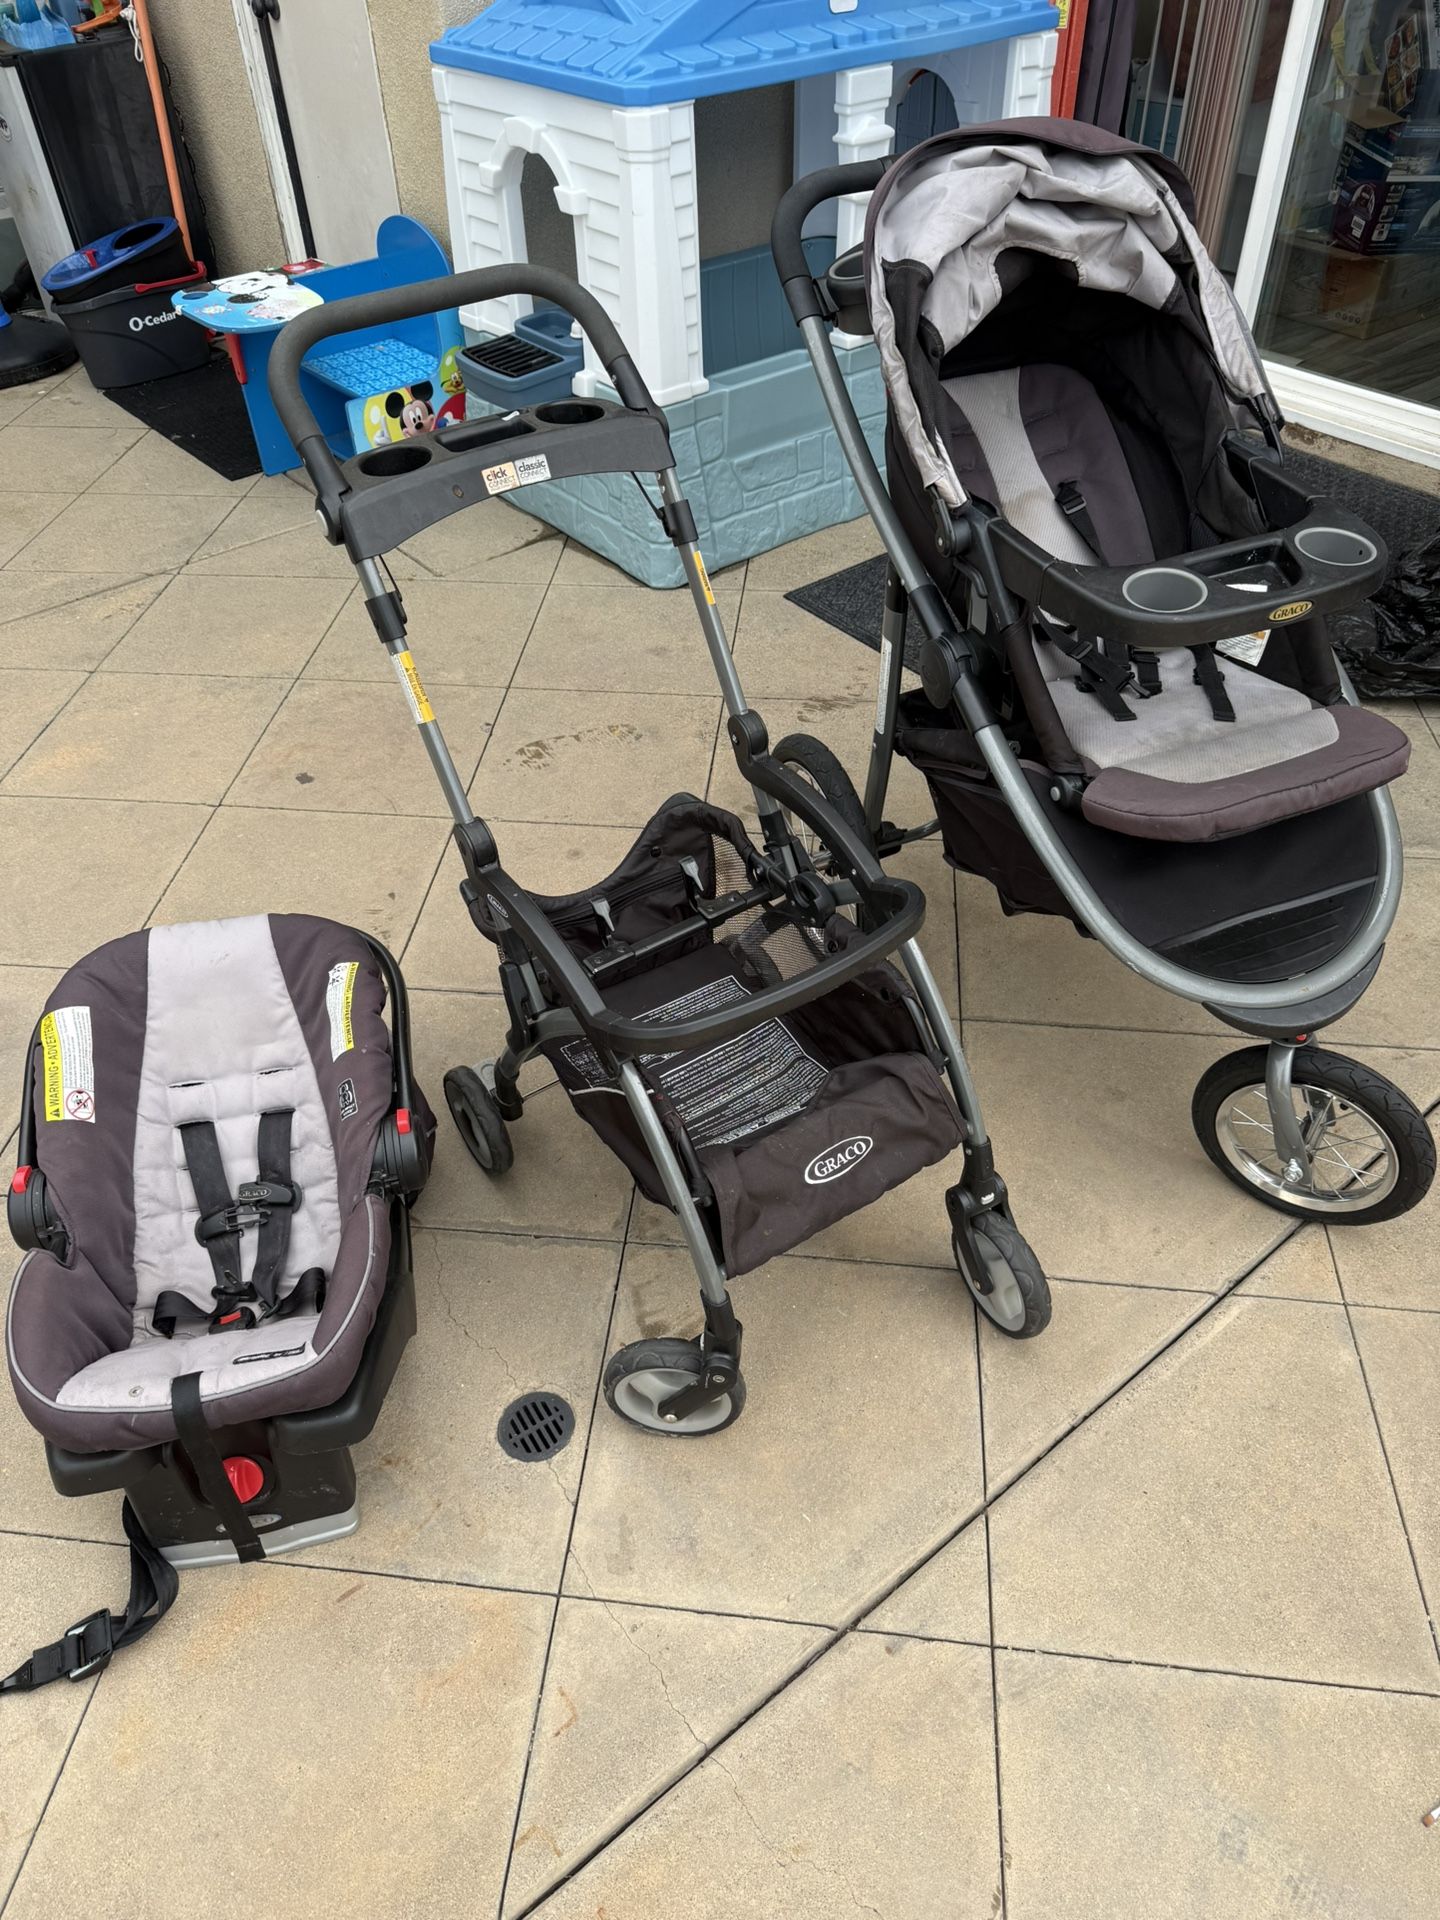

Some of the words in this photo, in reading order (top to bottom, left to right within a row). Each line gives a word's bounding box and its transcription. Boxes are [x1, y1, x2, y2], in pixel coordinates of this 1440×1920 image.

[129, 311, 177, 332] O-Cedar
[486, 466, 508, 482] click
[518, 459, 546, 473] classic
[1273, 602, 1309, 620] GRACO
[43, 1014, 59, 1061] ADVERTENCIA
[48, 1065, 61, 1108] WARNING
[814, 1141, 867, 1177] GRACO
